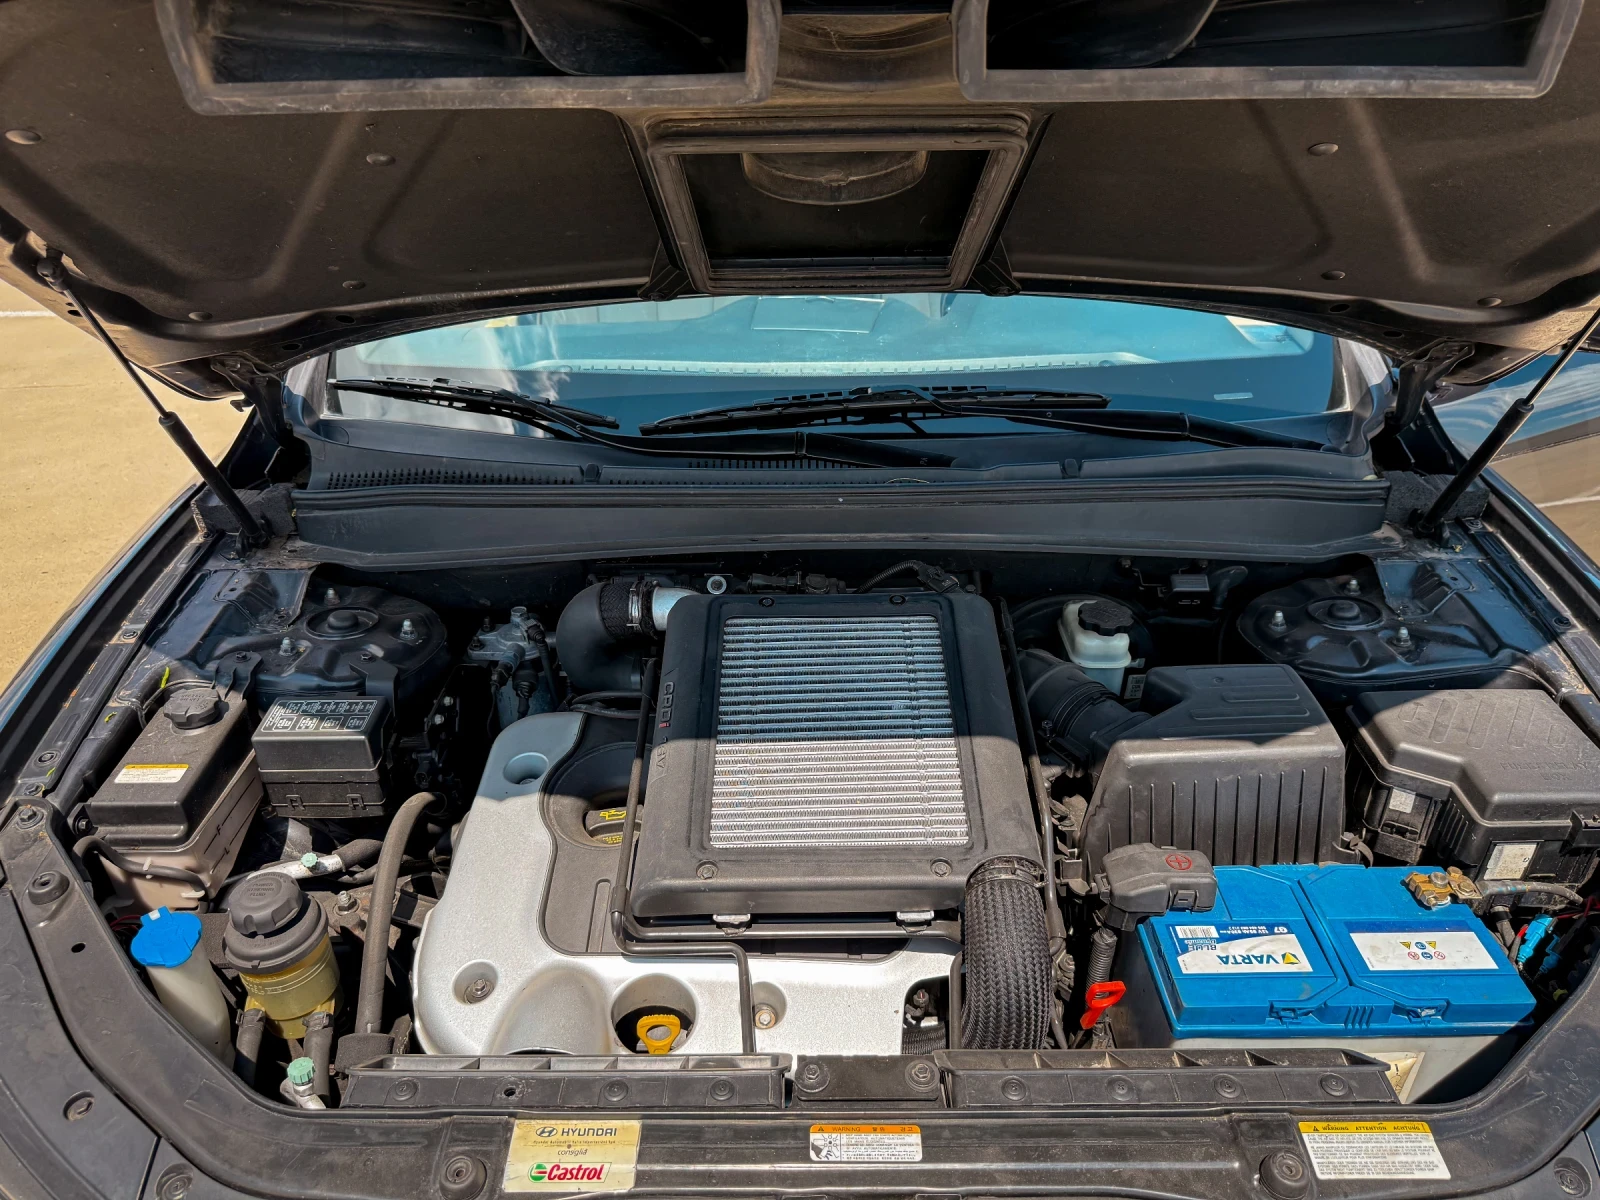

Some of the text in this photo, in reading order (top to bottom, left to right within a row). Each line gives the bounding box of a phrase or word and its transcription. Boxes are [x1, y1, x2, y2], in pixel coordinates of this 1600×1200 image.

[659, 681, 674, 727] CRDi
[1188, 944, 1217, 952] BLUE
[1216, 953, 1280, 965] VARTA
[561, 1127, 617, 1137] HYUNDAI
[557, 1148, 588, 1157] consiglia
[547, 1163, 605, 1181] Castrol
